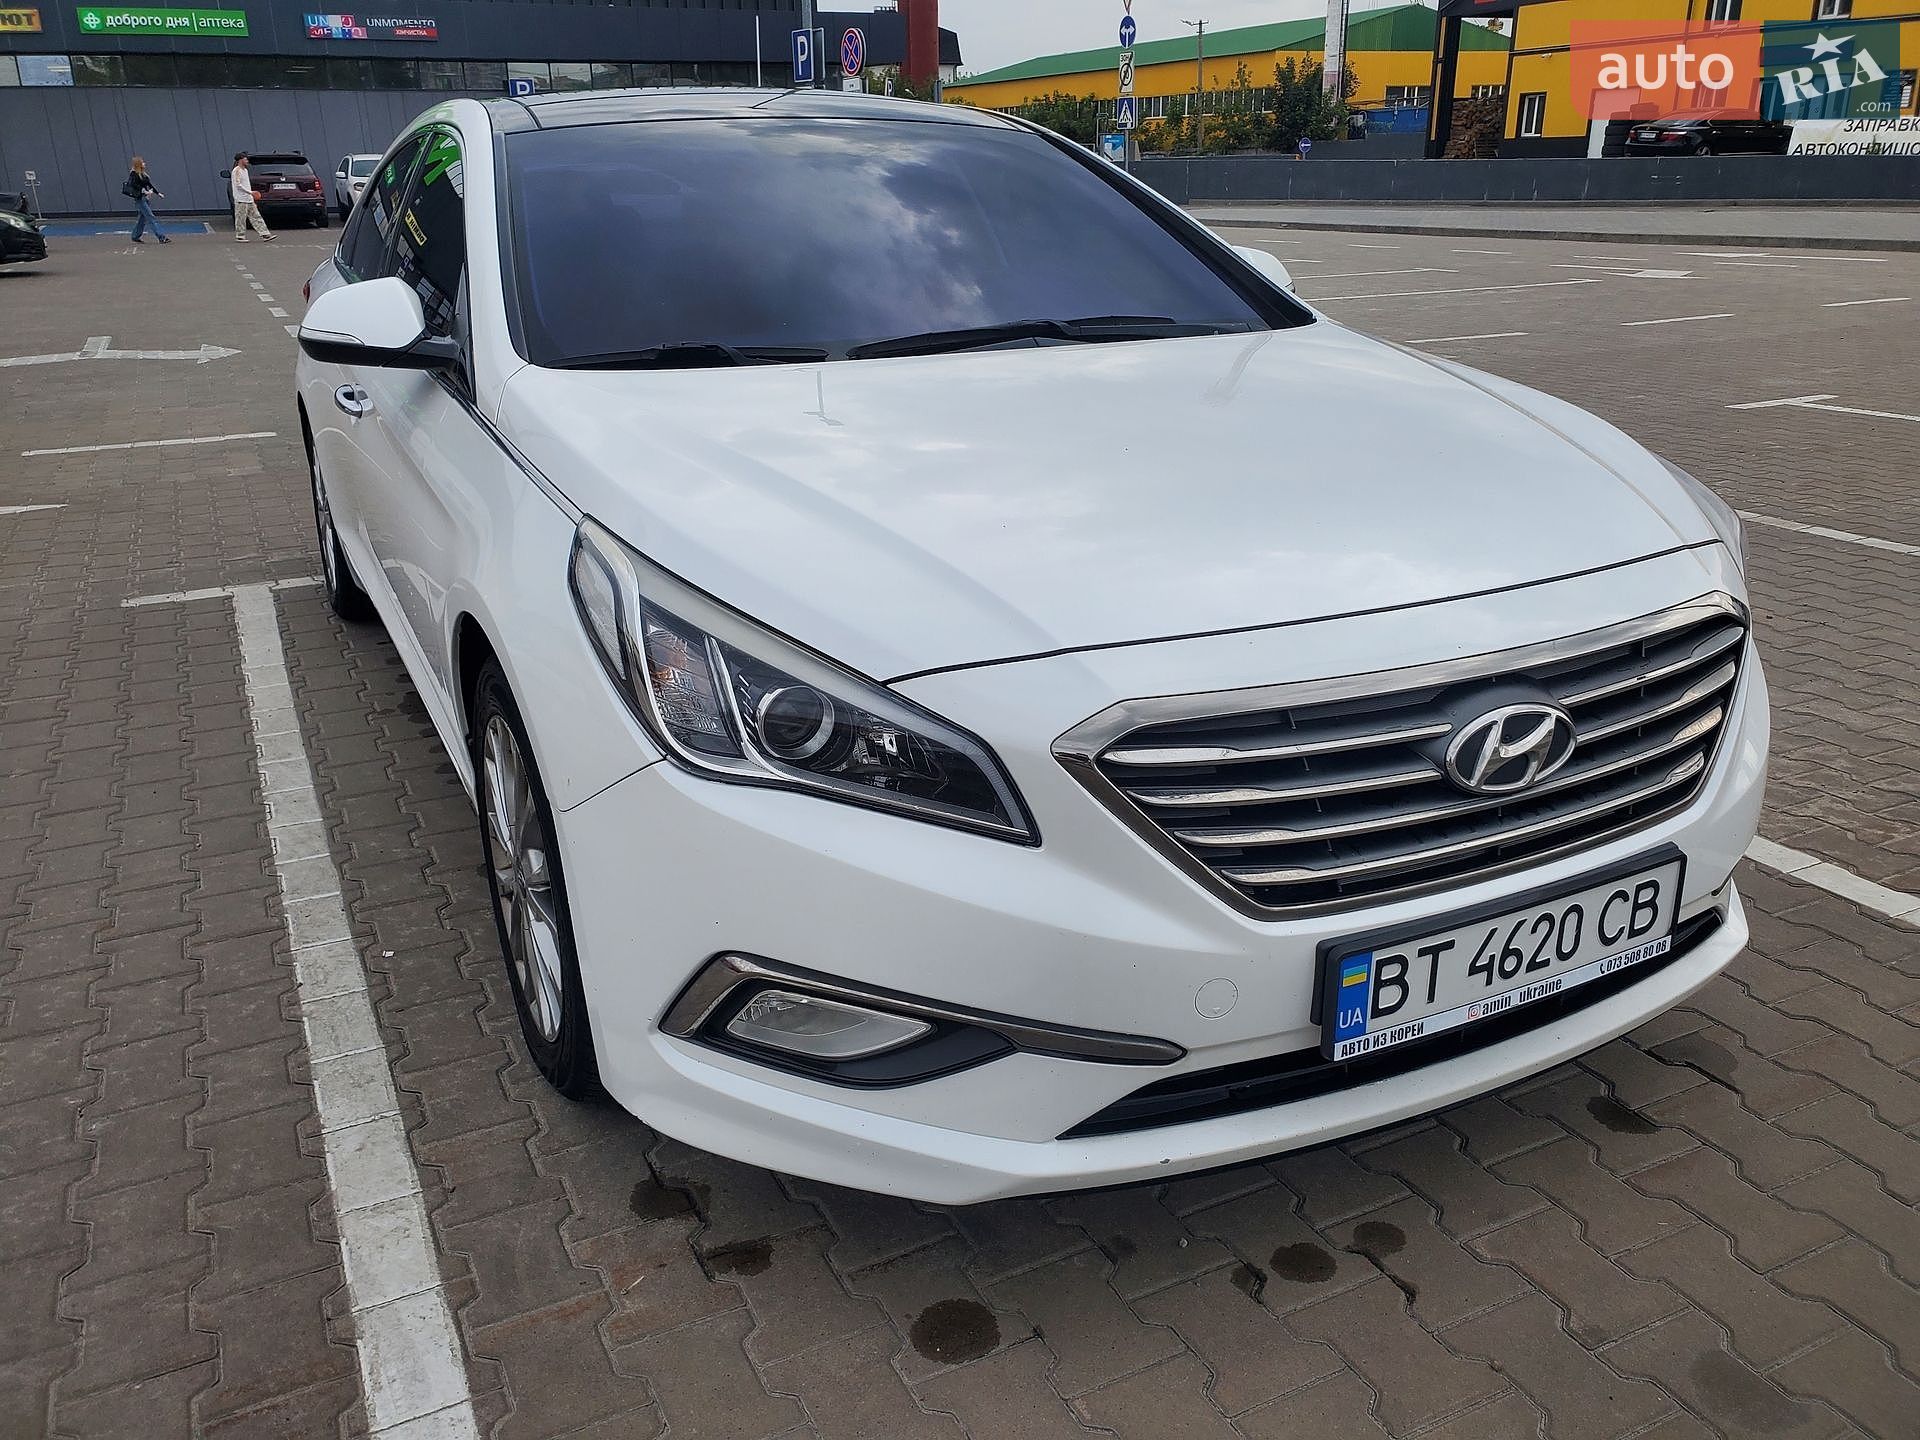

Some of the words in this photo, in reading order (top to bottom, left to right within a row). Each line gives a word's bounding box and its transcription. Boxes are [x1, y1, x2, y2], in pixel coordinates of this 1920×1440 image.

[106, 13, 162, 29] доброго
[165, 16, 190, 29] дня
[198, 16, 245, 29] аптека
[366, 18, 436, 28] UNMOMENTO
[1843, 118, 1920, 132] ЗАПРАВК
[1467, 903, 1584, 987] 4620
[1598, 878, 1661, 948] CB
[1606, 955, 1623, 973] 073
[1624, 949, 1641, 967] 508
[1642, 944, 1655, 960] 80
[1655, 939, 1667, 954] 08
[1339, 1010, 1364, 1030] UA
[1341, 1037, 1370, 1058] АВТО
[1372, 1032, 1388, 1049] ИЗ
